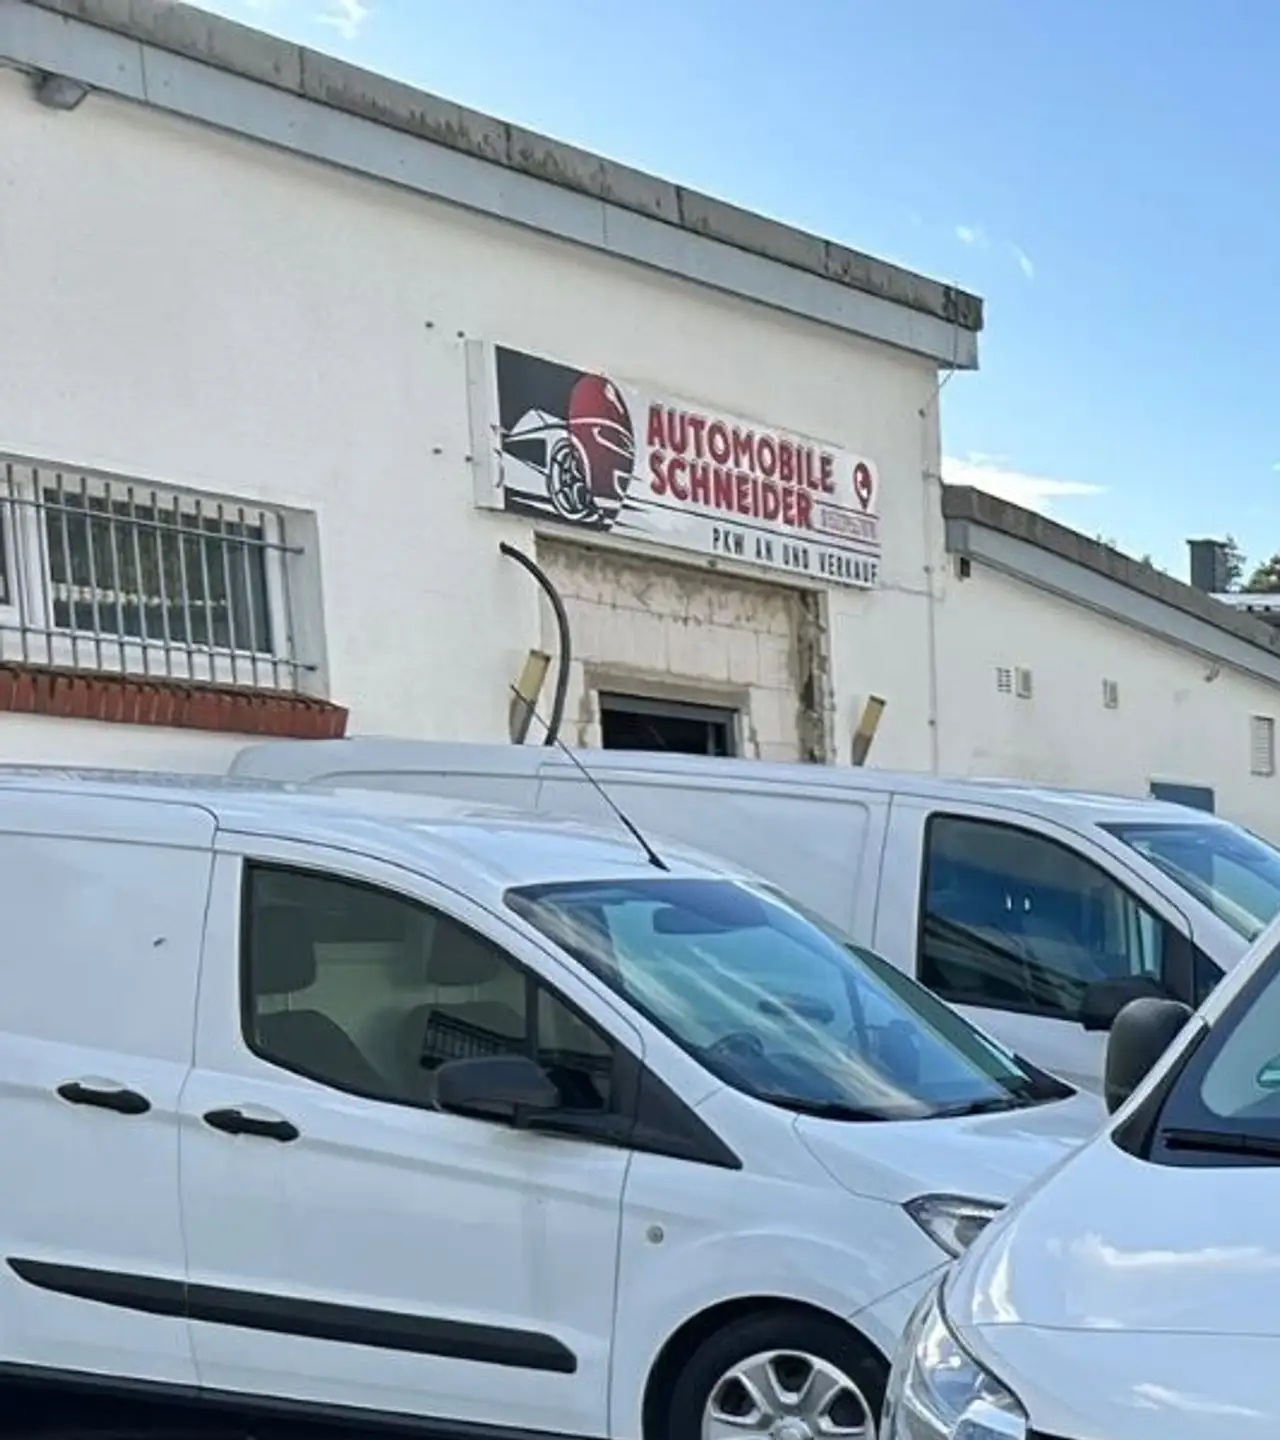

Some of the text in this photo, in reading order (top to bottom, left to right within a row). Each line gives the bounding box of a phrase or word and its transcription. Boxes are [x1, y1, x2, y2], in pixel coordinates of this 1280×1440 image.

[647, 404, 835, 493] AUTOMOBILE
[650, 450, 813, 530] SCHNEIDER
[713, 527, 878, 584] PKW AN UND VERKAUF
